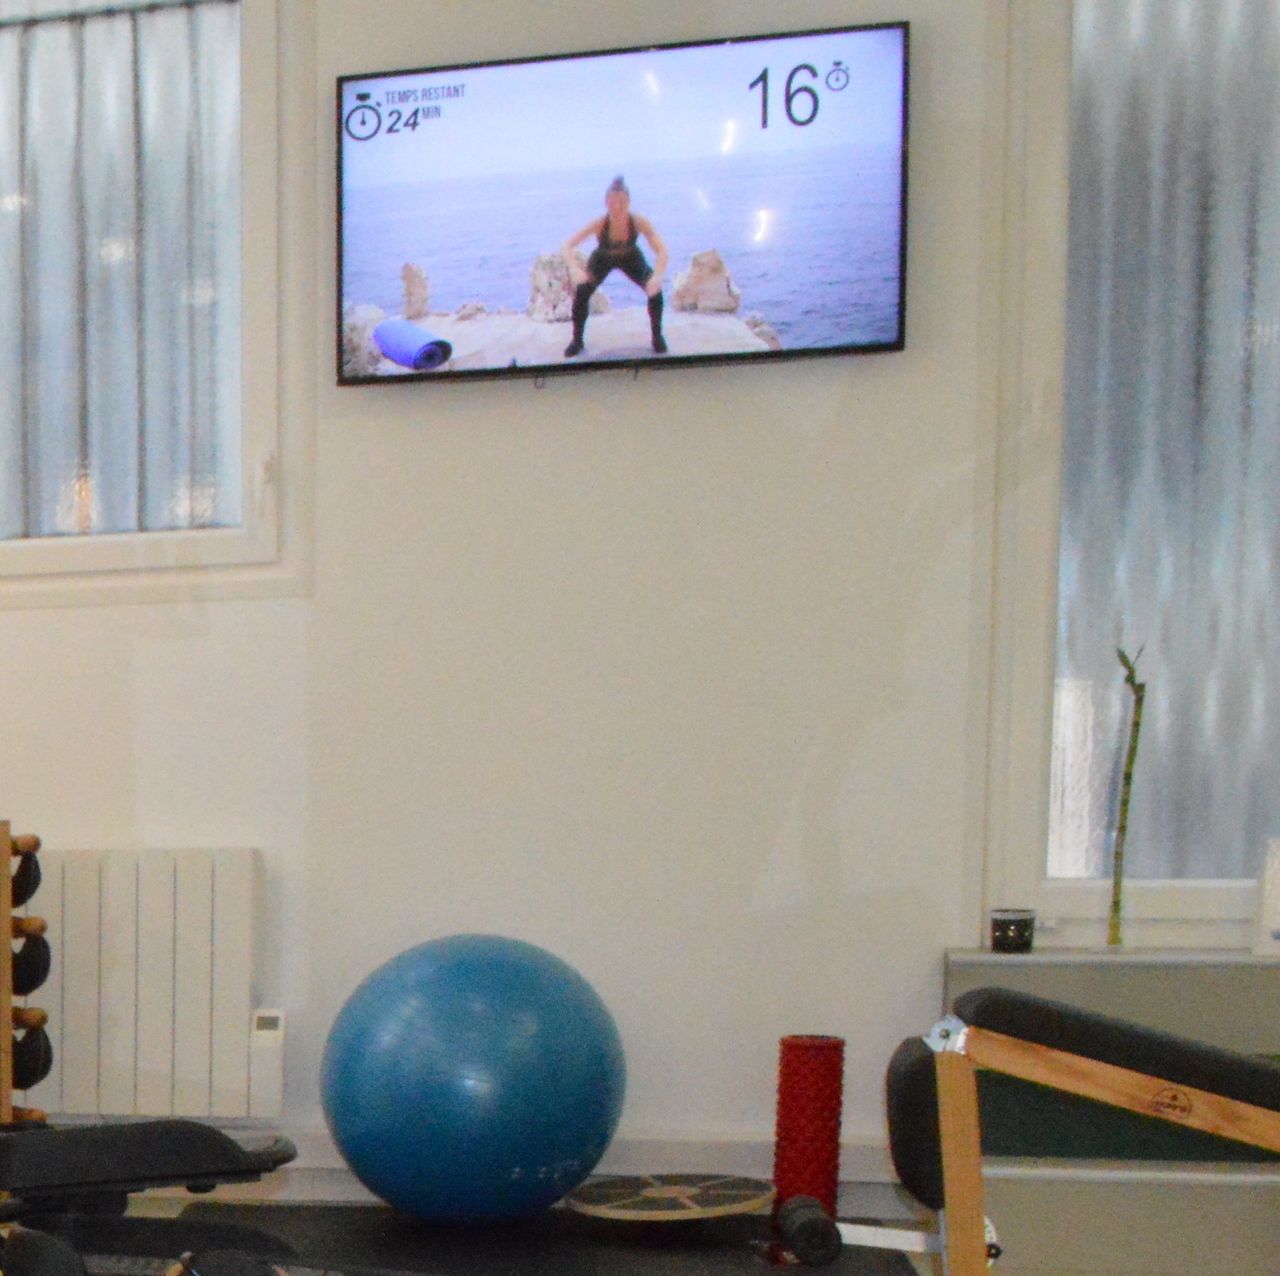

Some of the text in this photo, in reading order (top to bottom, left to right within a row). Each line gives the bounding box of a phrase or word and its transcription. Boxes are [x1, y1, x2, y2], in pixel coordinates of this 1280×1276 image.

[385, 84, 466, 105] TEMPS RESTANT
[747, 63, 819, 129] 16
[386, 105, 441, 134] 24 MIN
